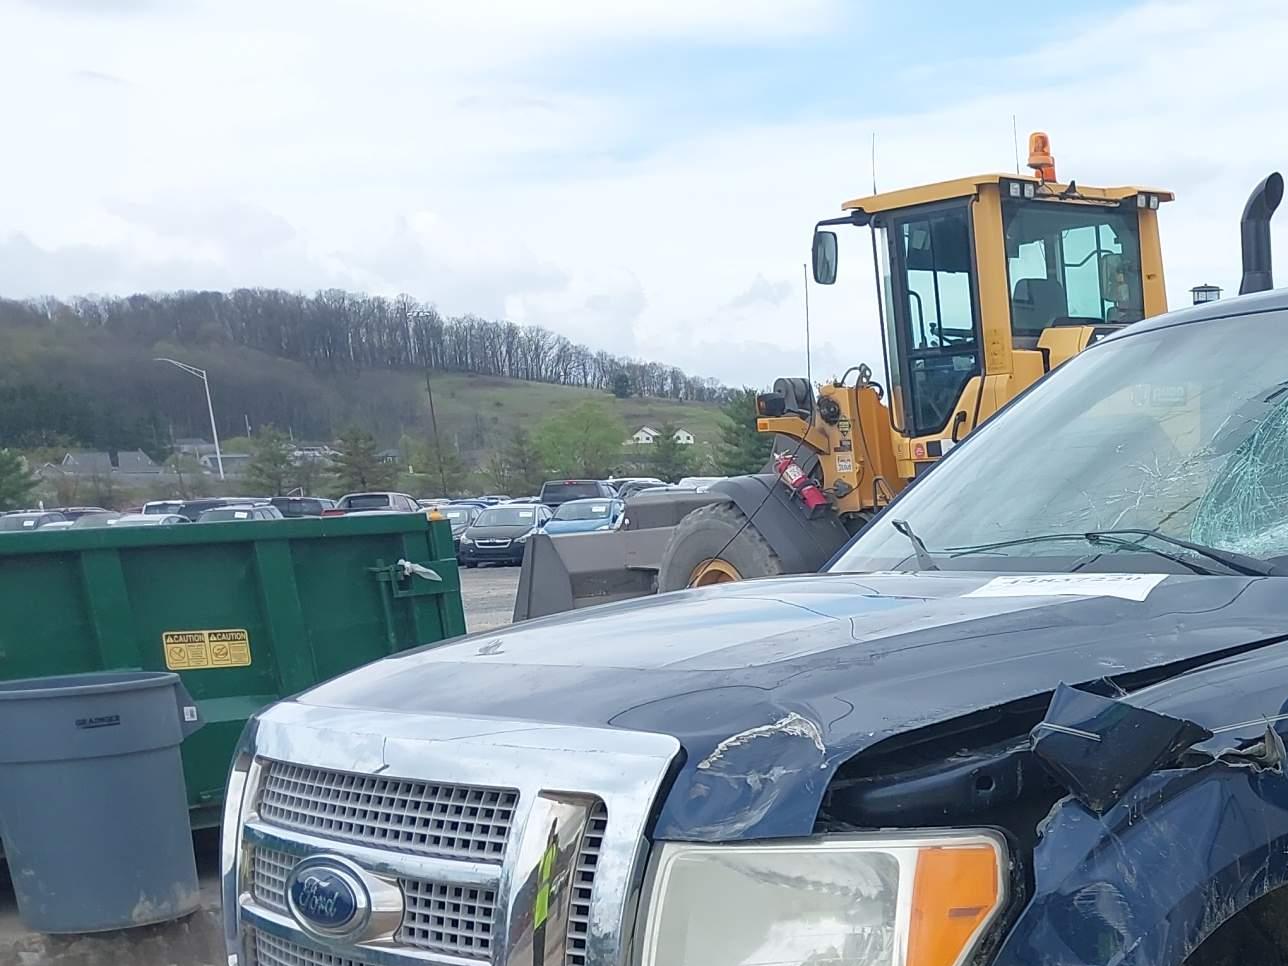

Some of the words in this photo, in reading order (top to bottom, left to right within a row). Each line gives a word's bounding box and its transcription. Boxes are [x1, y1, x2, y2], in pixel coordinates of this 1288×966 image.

[173, 634, 205, 642] CAUTION
[217, 632, 246, 641] CAUTION
[299, 875, 339, 917] Ford
